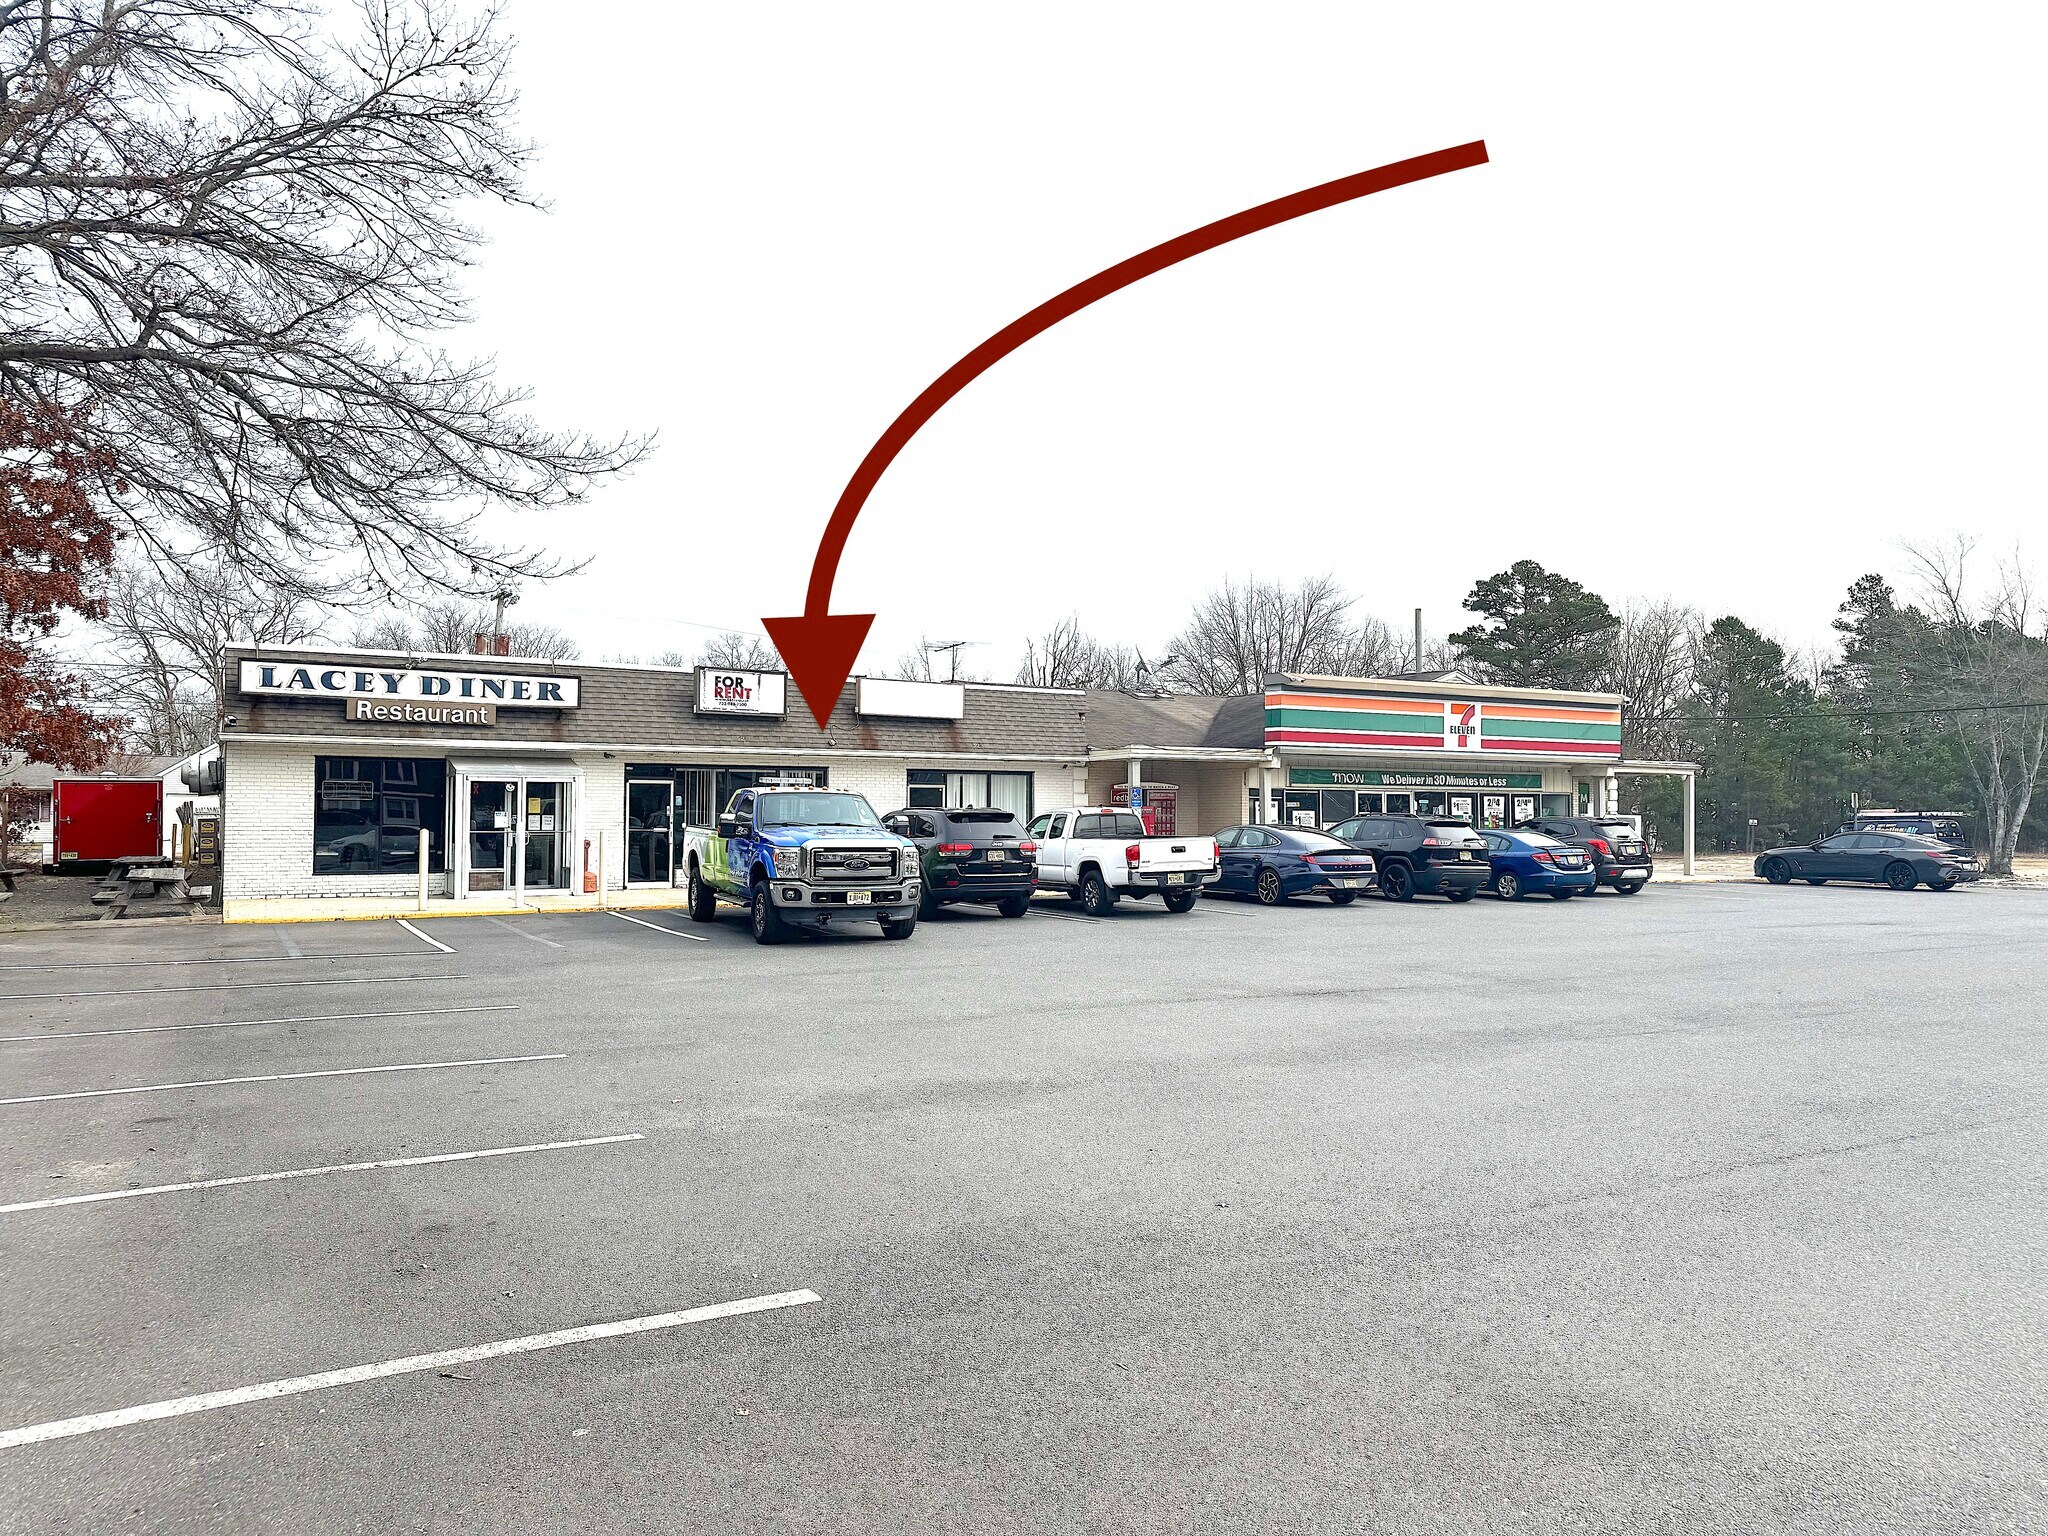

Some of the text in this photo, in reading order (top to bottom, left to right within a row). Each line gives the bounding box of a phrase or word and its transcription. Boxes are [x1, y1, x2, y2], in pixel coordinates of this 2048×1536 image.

[258, 665, 565, 702] LACEY DINER
[714, 676, 744, 688] FOR
[714, 686, 752, 699] RENT
[355, 700, 488, 724] Restaurant
[1451, 703, 1476, 748] 7
[1381, 774, 1396, 785] We
[1396, 774, 1425, 786] Deliver
[1425, 774, 1434, 786] in
[1434, 775, 1445, 786] 30
[1446, 775, 1479, 787] Minutes
[1479, 777, 1488, 787] or
[1488, 776, 1507, 787] Less
[1113, 793, 1129, 802] redb
[850, 859, 865, 868] Ford
